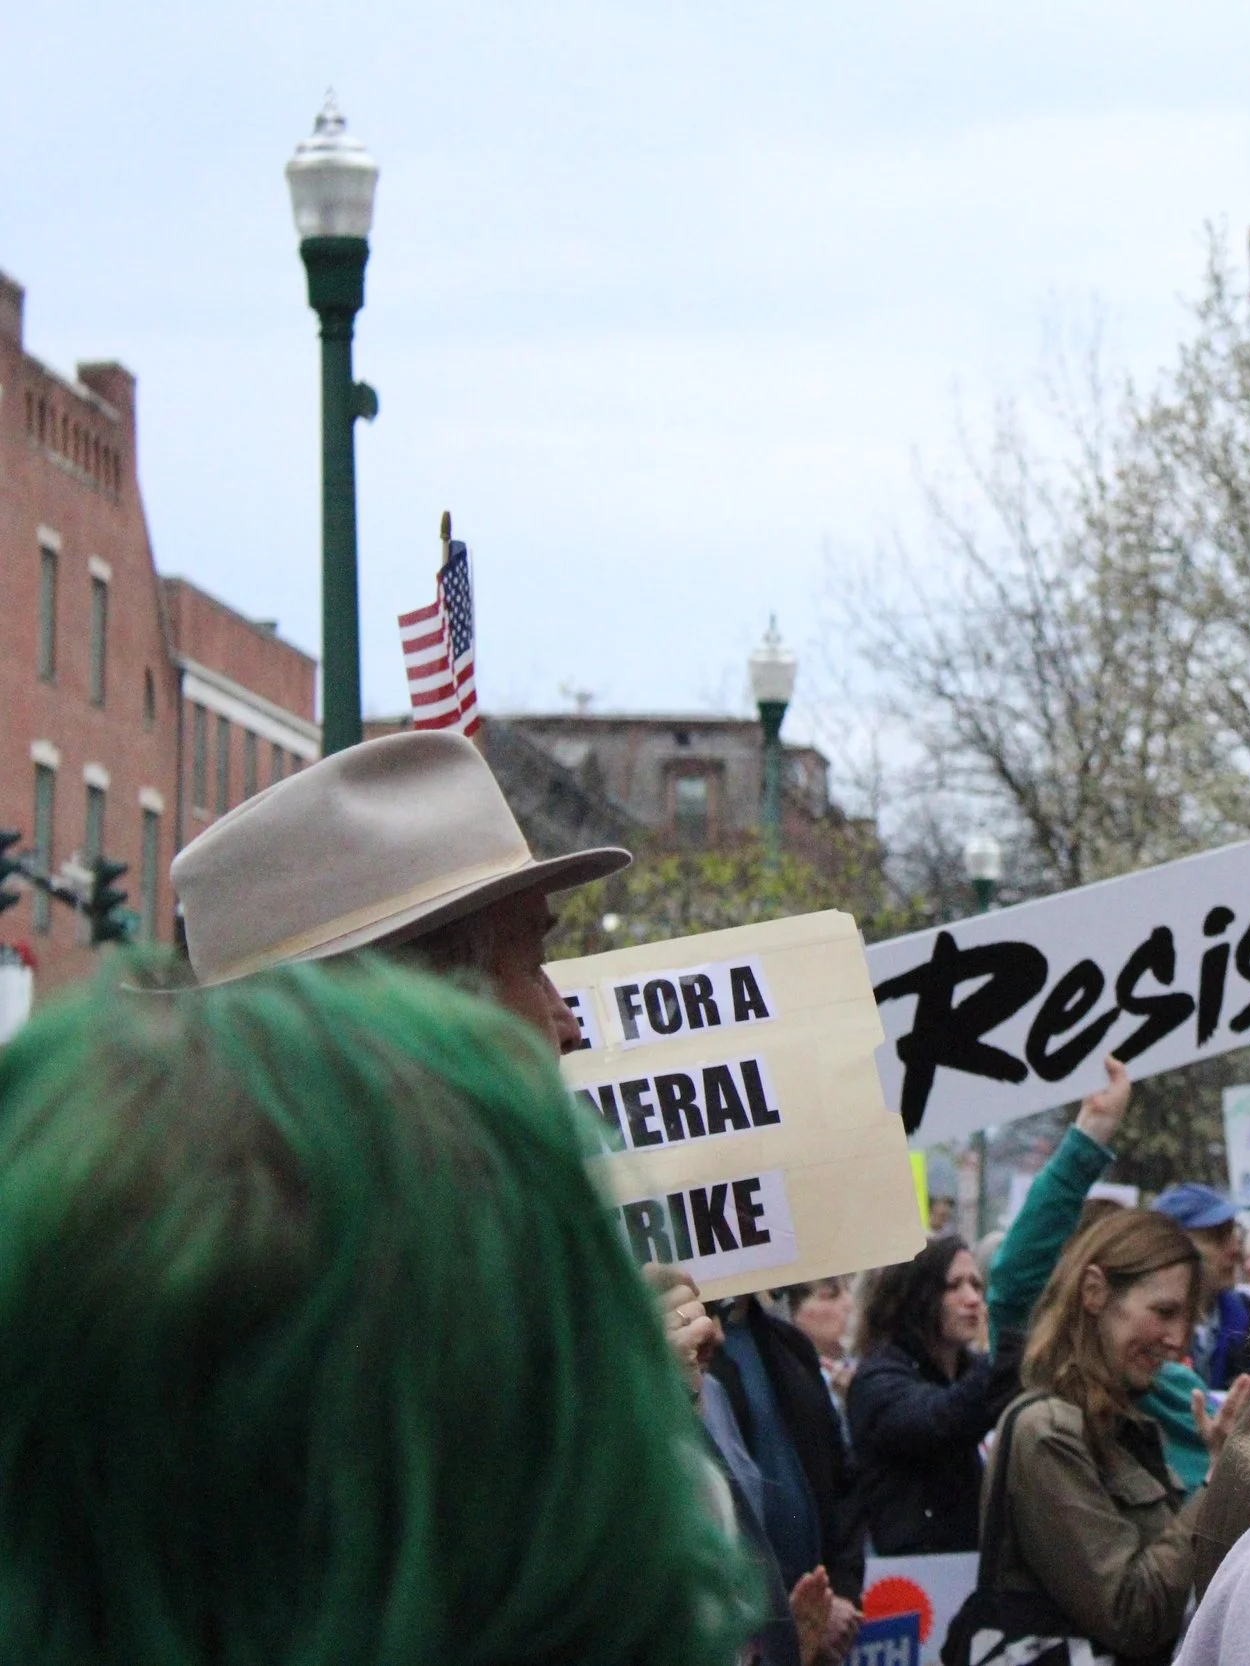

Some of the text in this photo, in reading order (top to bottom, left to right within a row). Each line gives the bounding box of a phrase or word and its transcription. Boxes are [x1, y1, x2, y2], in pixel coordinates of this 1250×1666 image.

[613, 973, 721, 1041] FOR
[729, 965, 770, 1022] A
[575, 1059, 781, 1153] NERAL
[612, 1177, 771, 1265] RIKE
